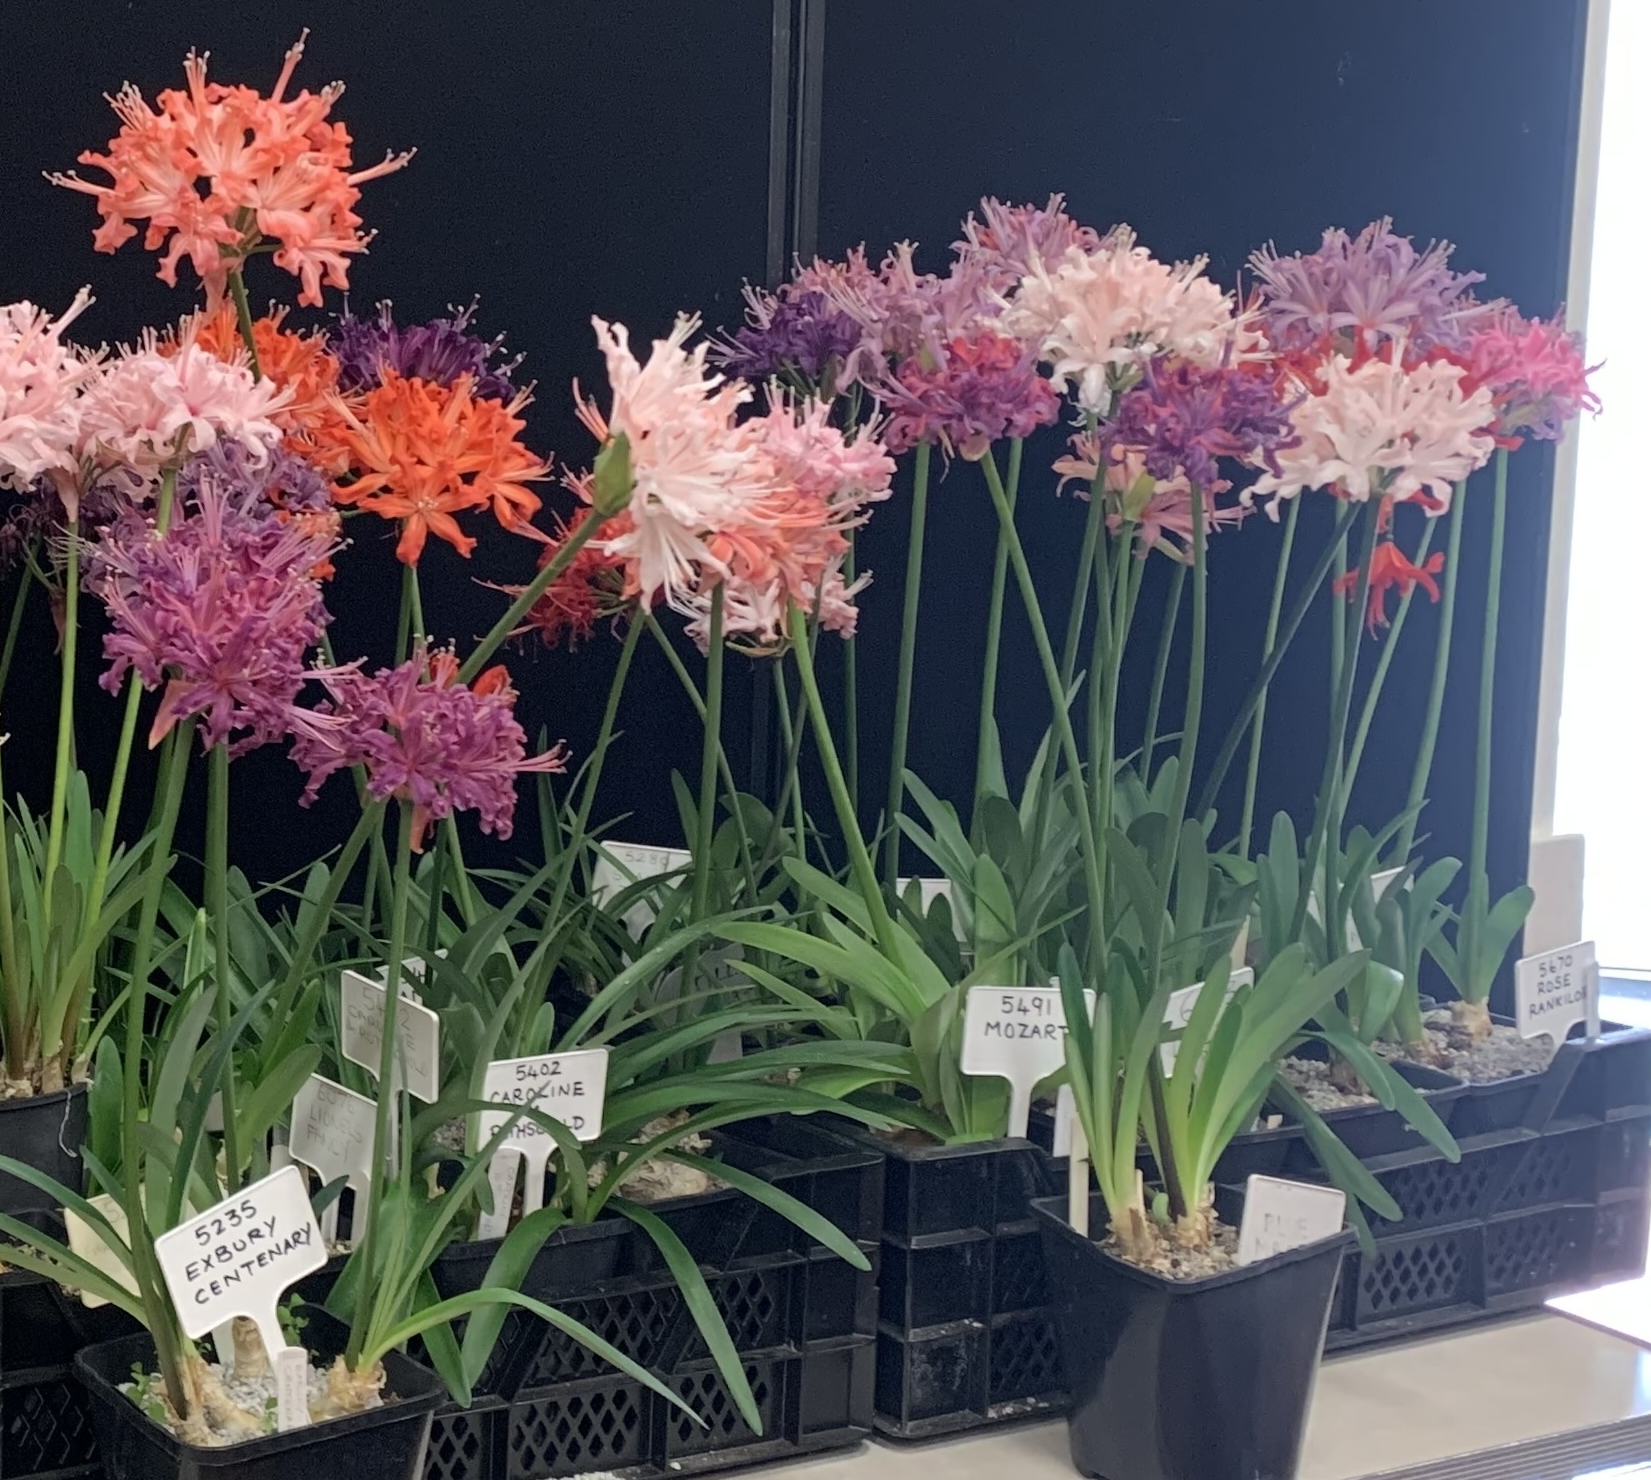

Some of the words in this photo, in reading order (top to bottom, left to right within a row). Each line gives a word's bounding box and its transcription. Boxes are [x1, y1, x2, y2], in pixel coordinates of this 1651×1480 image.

[1539, 955, 1573, 978] 5670
[1537, 973, 1571, 996] ROSE
[1001, 995, 1052, 1016] 5491
[515, 1060, 562, 1081] 5402
[194, 1199, 258, 1246] 5235
[185, 1215, 277, 1282] EXBURY
[194, 1221, 311, 1305] CENTENARY
